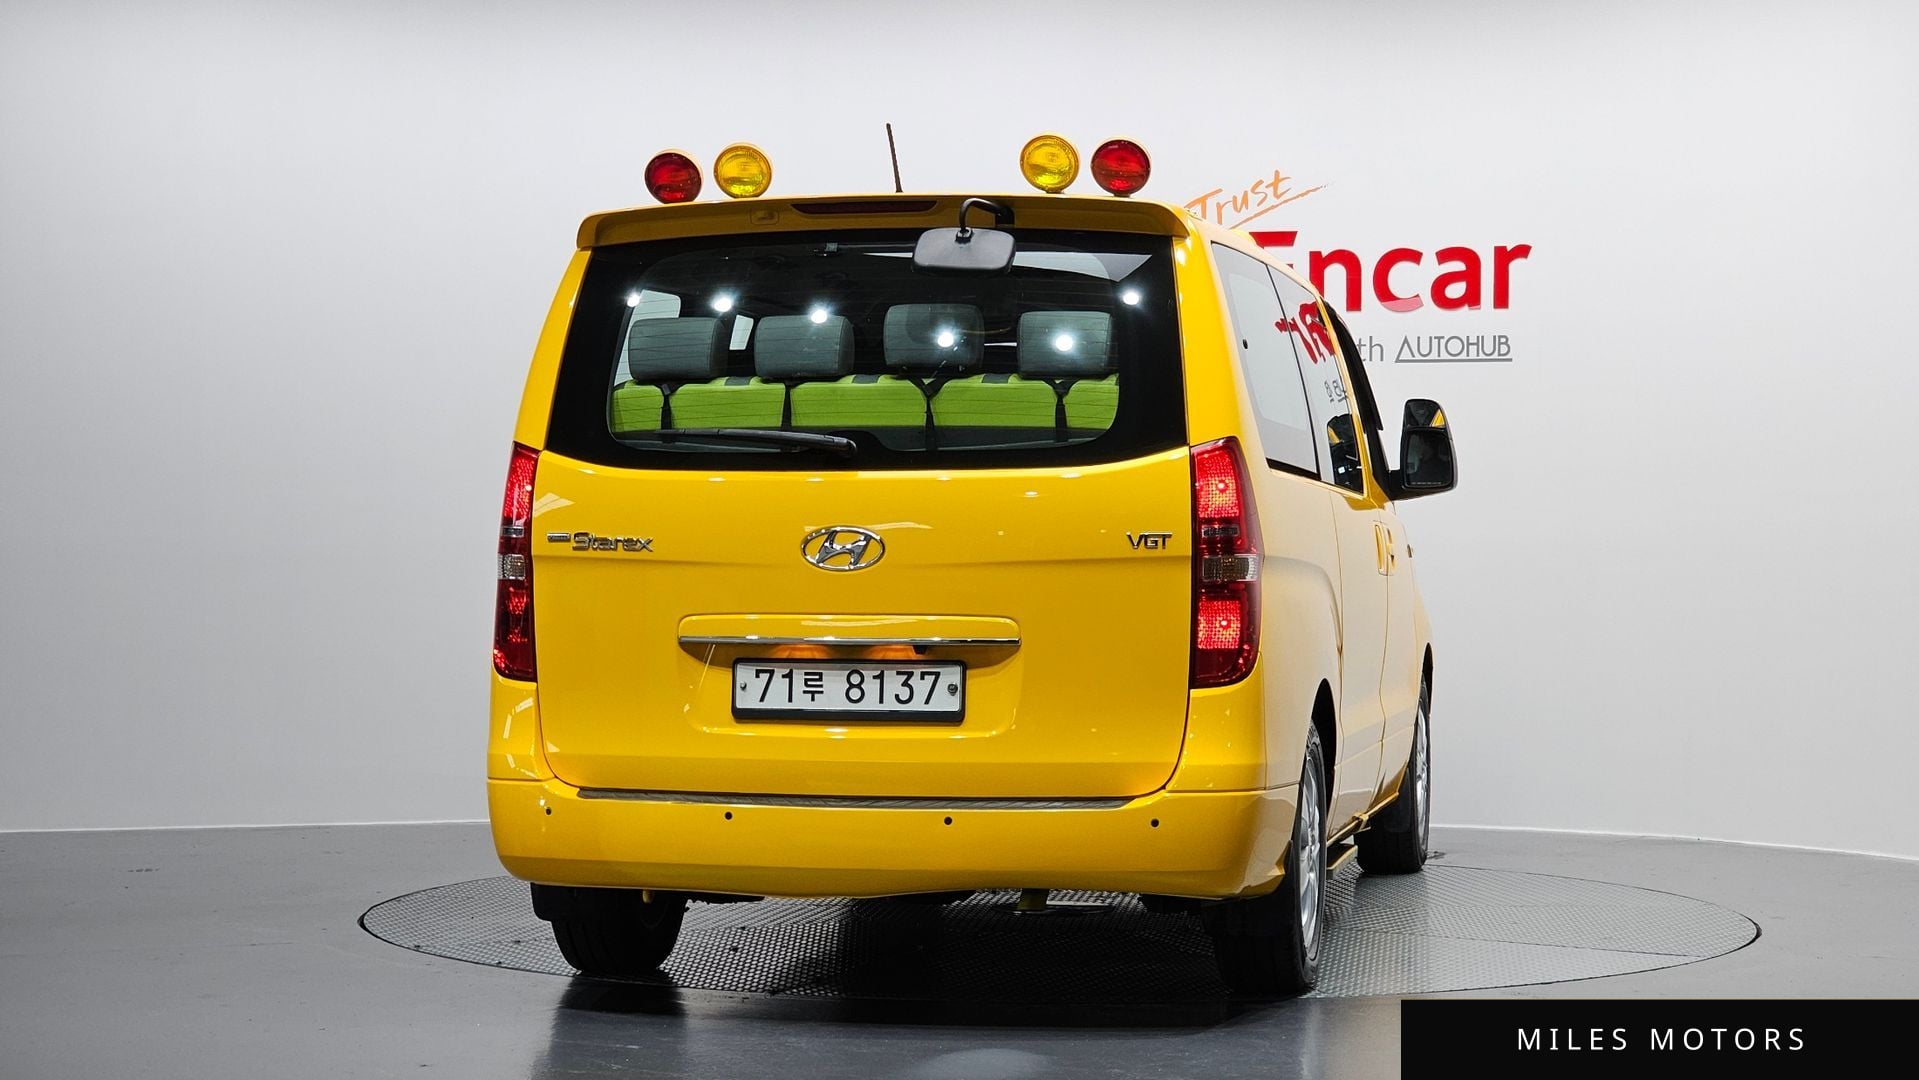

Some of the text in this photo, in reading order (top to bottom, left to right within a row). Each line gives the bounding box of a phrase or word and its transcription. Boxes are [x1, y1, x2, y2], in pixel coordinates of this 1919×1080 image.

[1184, 170, 1292, 225] Trust
[1395, 335, 1513, 363] AUTOHUB
[572, 532, 654, 552] Starex
[1126, 532, 1173, 550] VGT
[754, 668, 941, 705] 71루 8137
